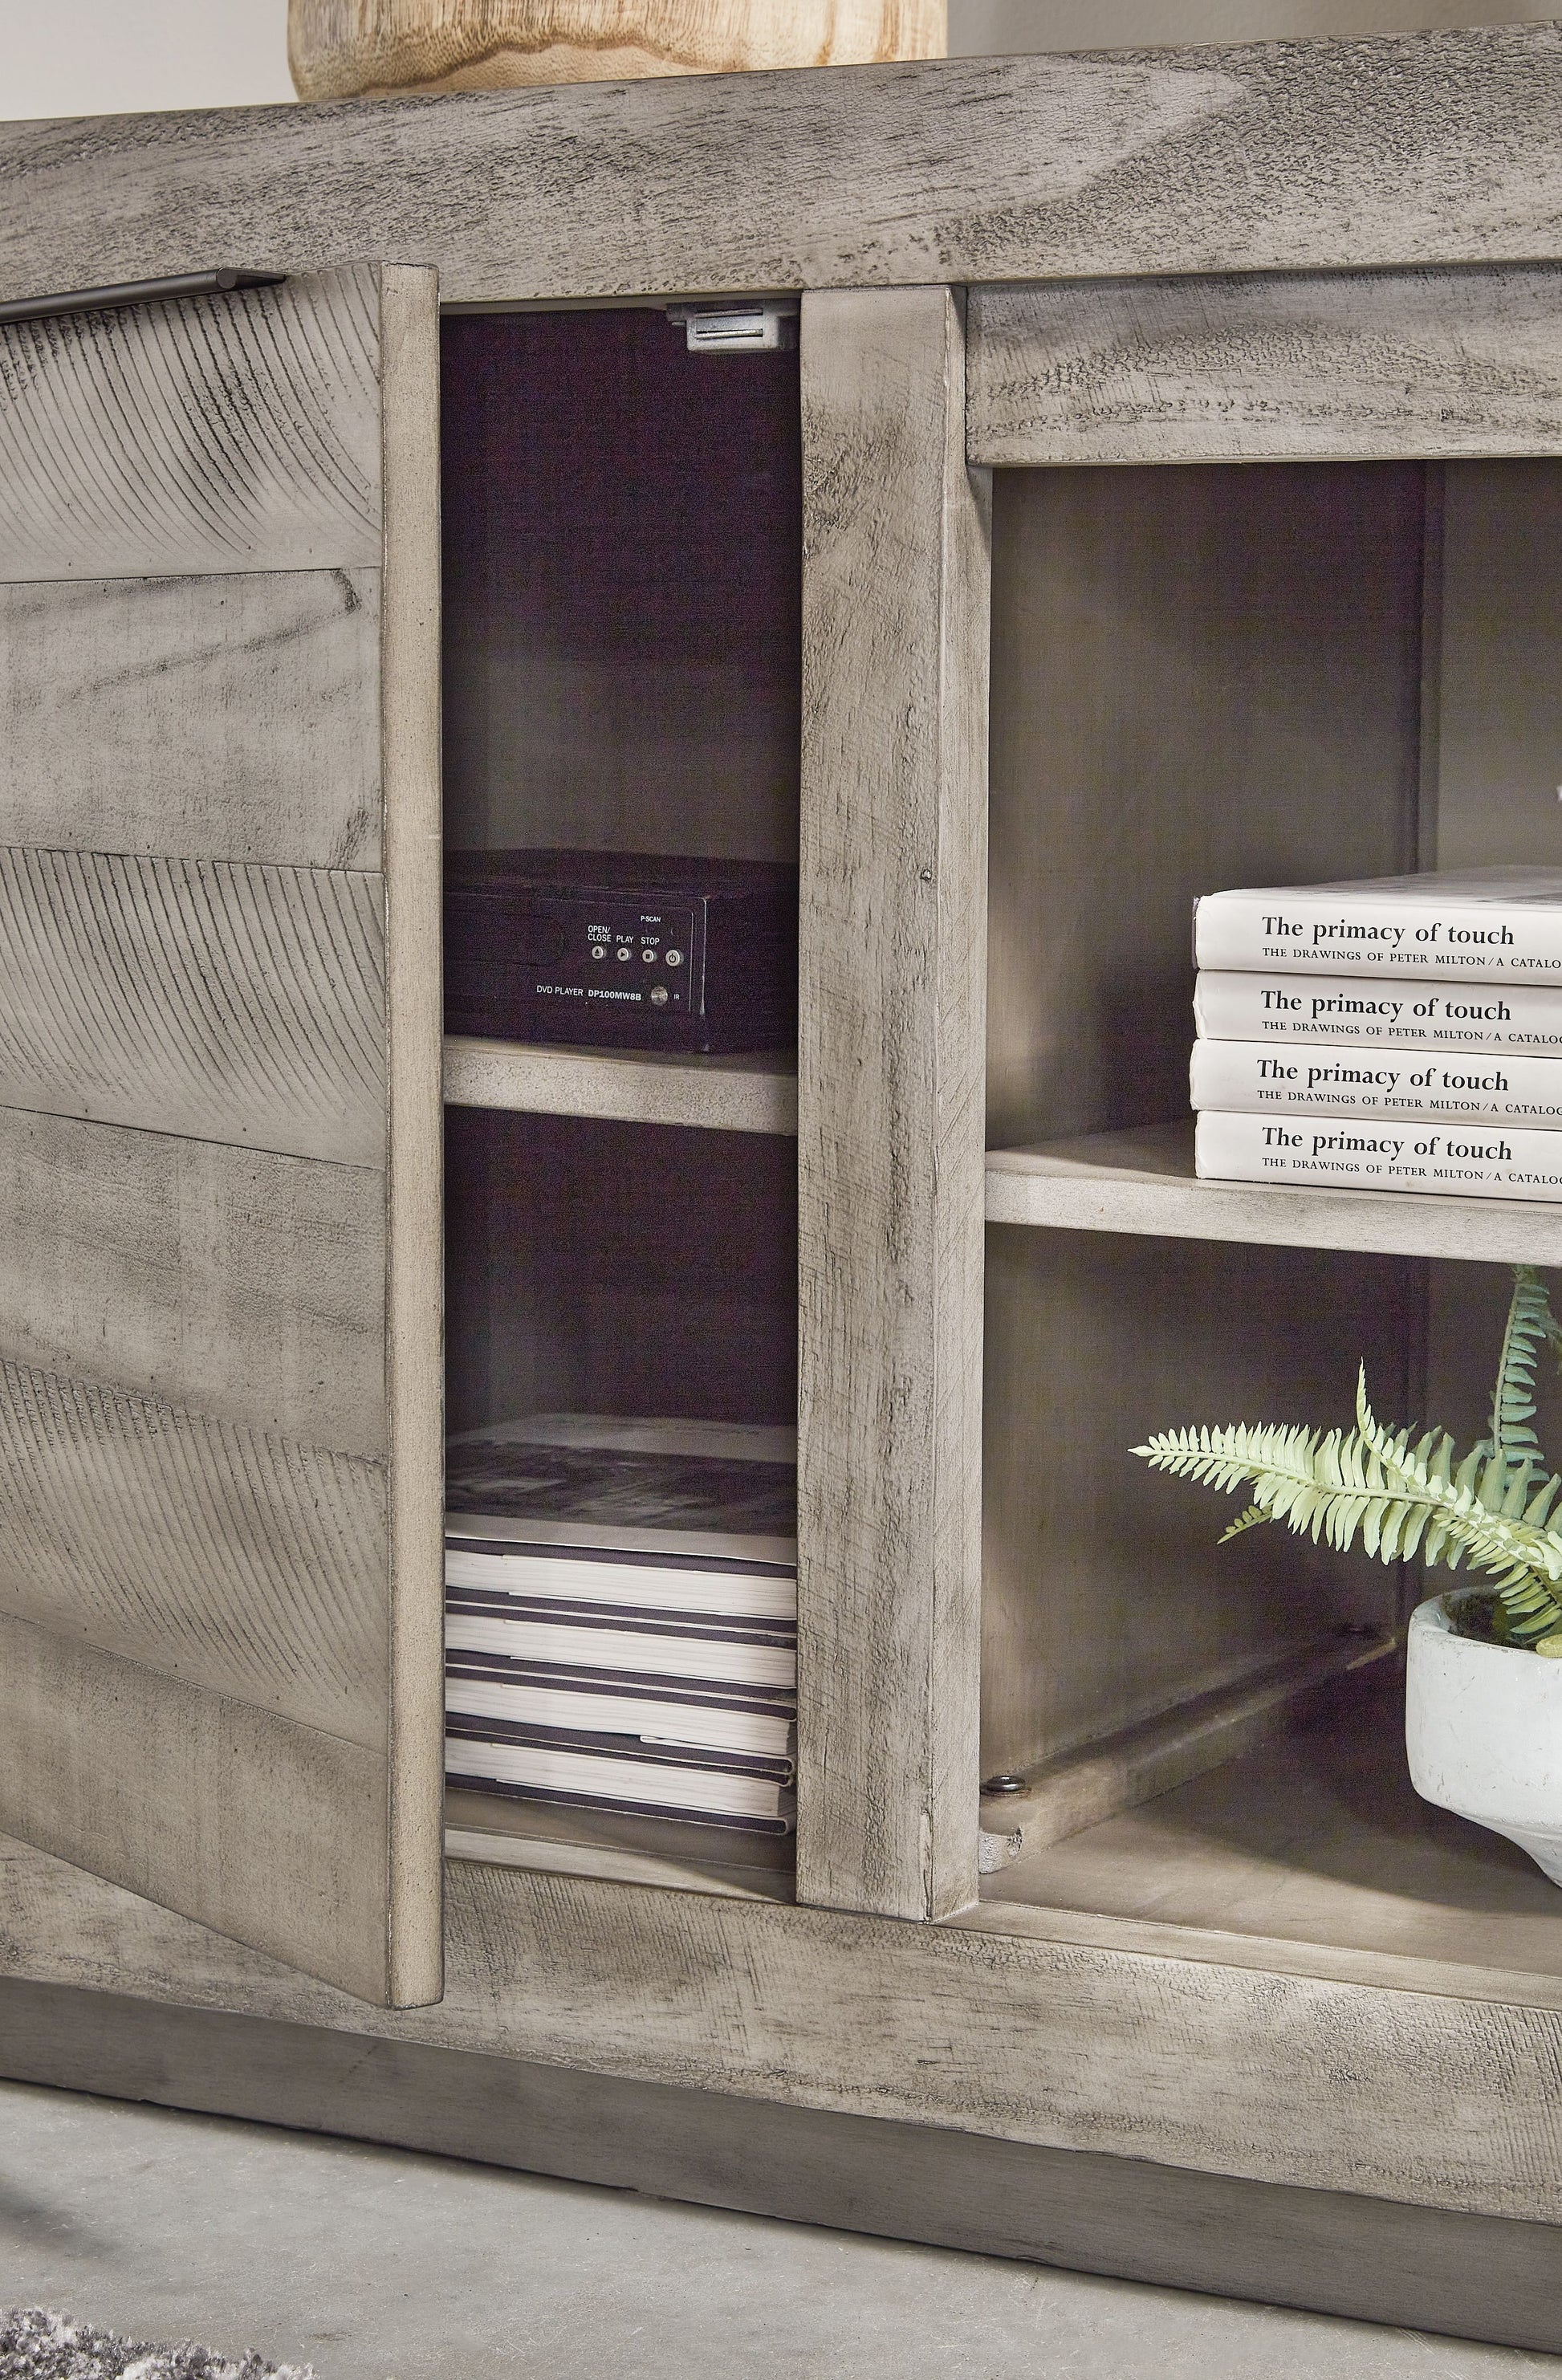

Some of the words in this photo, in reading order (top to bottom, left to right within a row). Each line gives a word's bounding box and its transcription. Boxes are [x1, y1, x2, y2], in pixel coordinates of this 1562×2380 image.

[588, 926, 611, 934] OPEN/
[1262, 916, 1304, 937] The
[1312, 918, 1406, 949] primacy
[1415, 922, 1442, 942] of
[1448, 925, 1515, 945] touch
[588, 934, 612, 942] CLOSE
[616, 935, 634, 944] PLAY
[641, 937, 660, 946] STOP
[1262, 947, 1287, 958] THE
[1292, 949, 1361, 961] DRAWINGS
[1367, 952, 1385, 962] OF
[1389, 953, 1429, 963] PETER
[536, 985, 553, 994] DVD
[555, 987, 584, 997] PLAYER
[588, 989, 642, 1001] DP100MW8B
[1260, 990, 1302, 1011] The
[1311, 993, 1404, 1023] primacy
[1413, 997, 1440, 1017] of
[1445, 1000, 1511, 1021] touch
[1262, 1020, 1287, 1031] THE
[1292, 1022, 1361, 1035] DRAWINGS
[1365, 1026, 1383, 1035] OF
[1388, 1027, 1427, 1038] PETER
[1256, 1059, 1299, 1080] The
[1307, 1063, 1401, 1093] primacy
[1409, 1068, 1437, 1087] of
[1442, 1071, 1509, 1092] touch
[1257, 1089, 1283, 1100] THE
[1287, 1092, 1357, 1105] DRAWINGS
[1361, 1096, 1379, 1105] OF
[1384, 1097, 1424, 1108] PETER
[1262, 1126, 1304, 1147] The
[1312, 1130, 1405, 1162] primacy
[1414, 1136, 1441, 1156] of
[1446, 1141, 1512, 1161] touch
[1262, 1157, 1287, 1167] THE
[1292, 1159, 1361, 1173] DRAWINGS
[1365, 1164, 1383, 1174] OF
[1388, 1166, 1427, 1177] PETER
